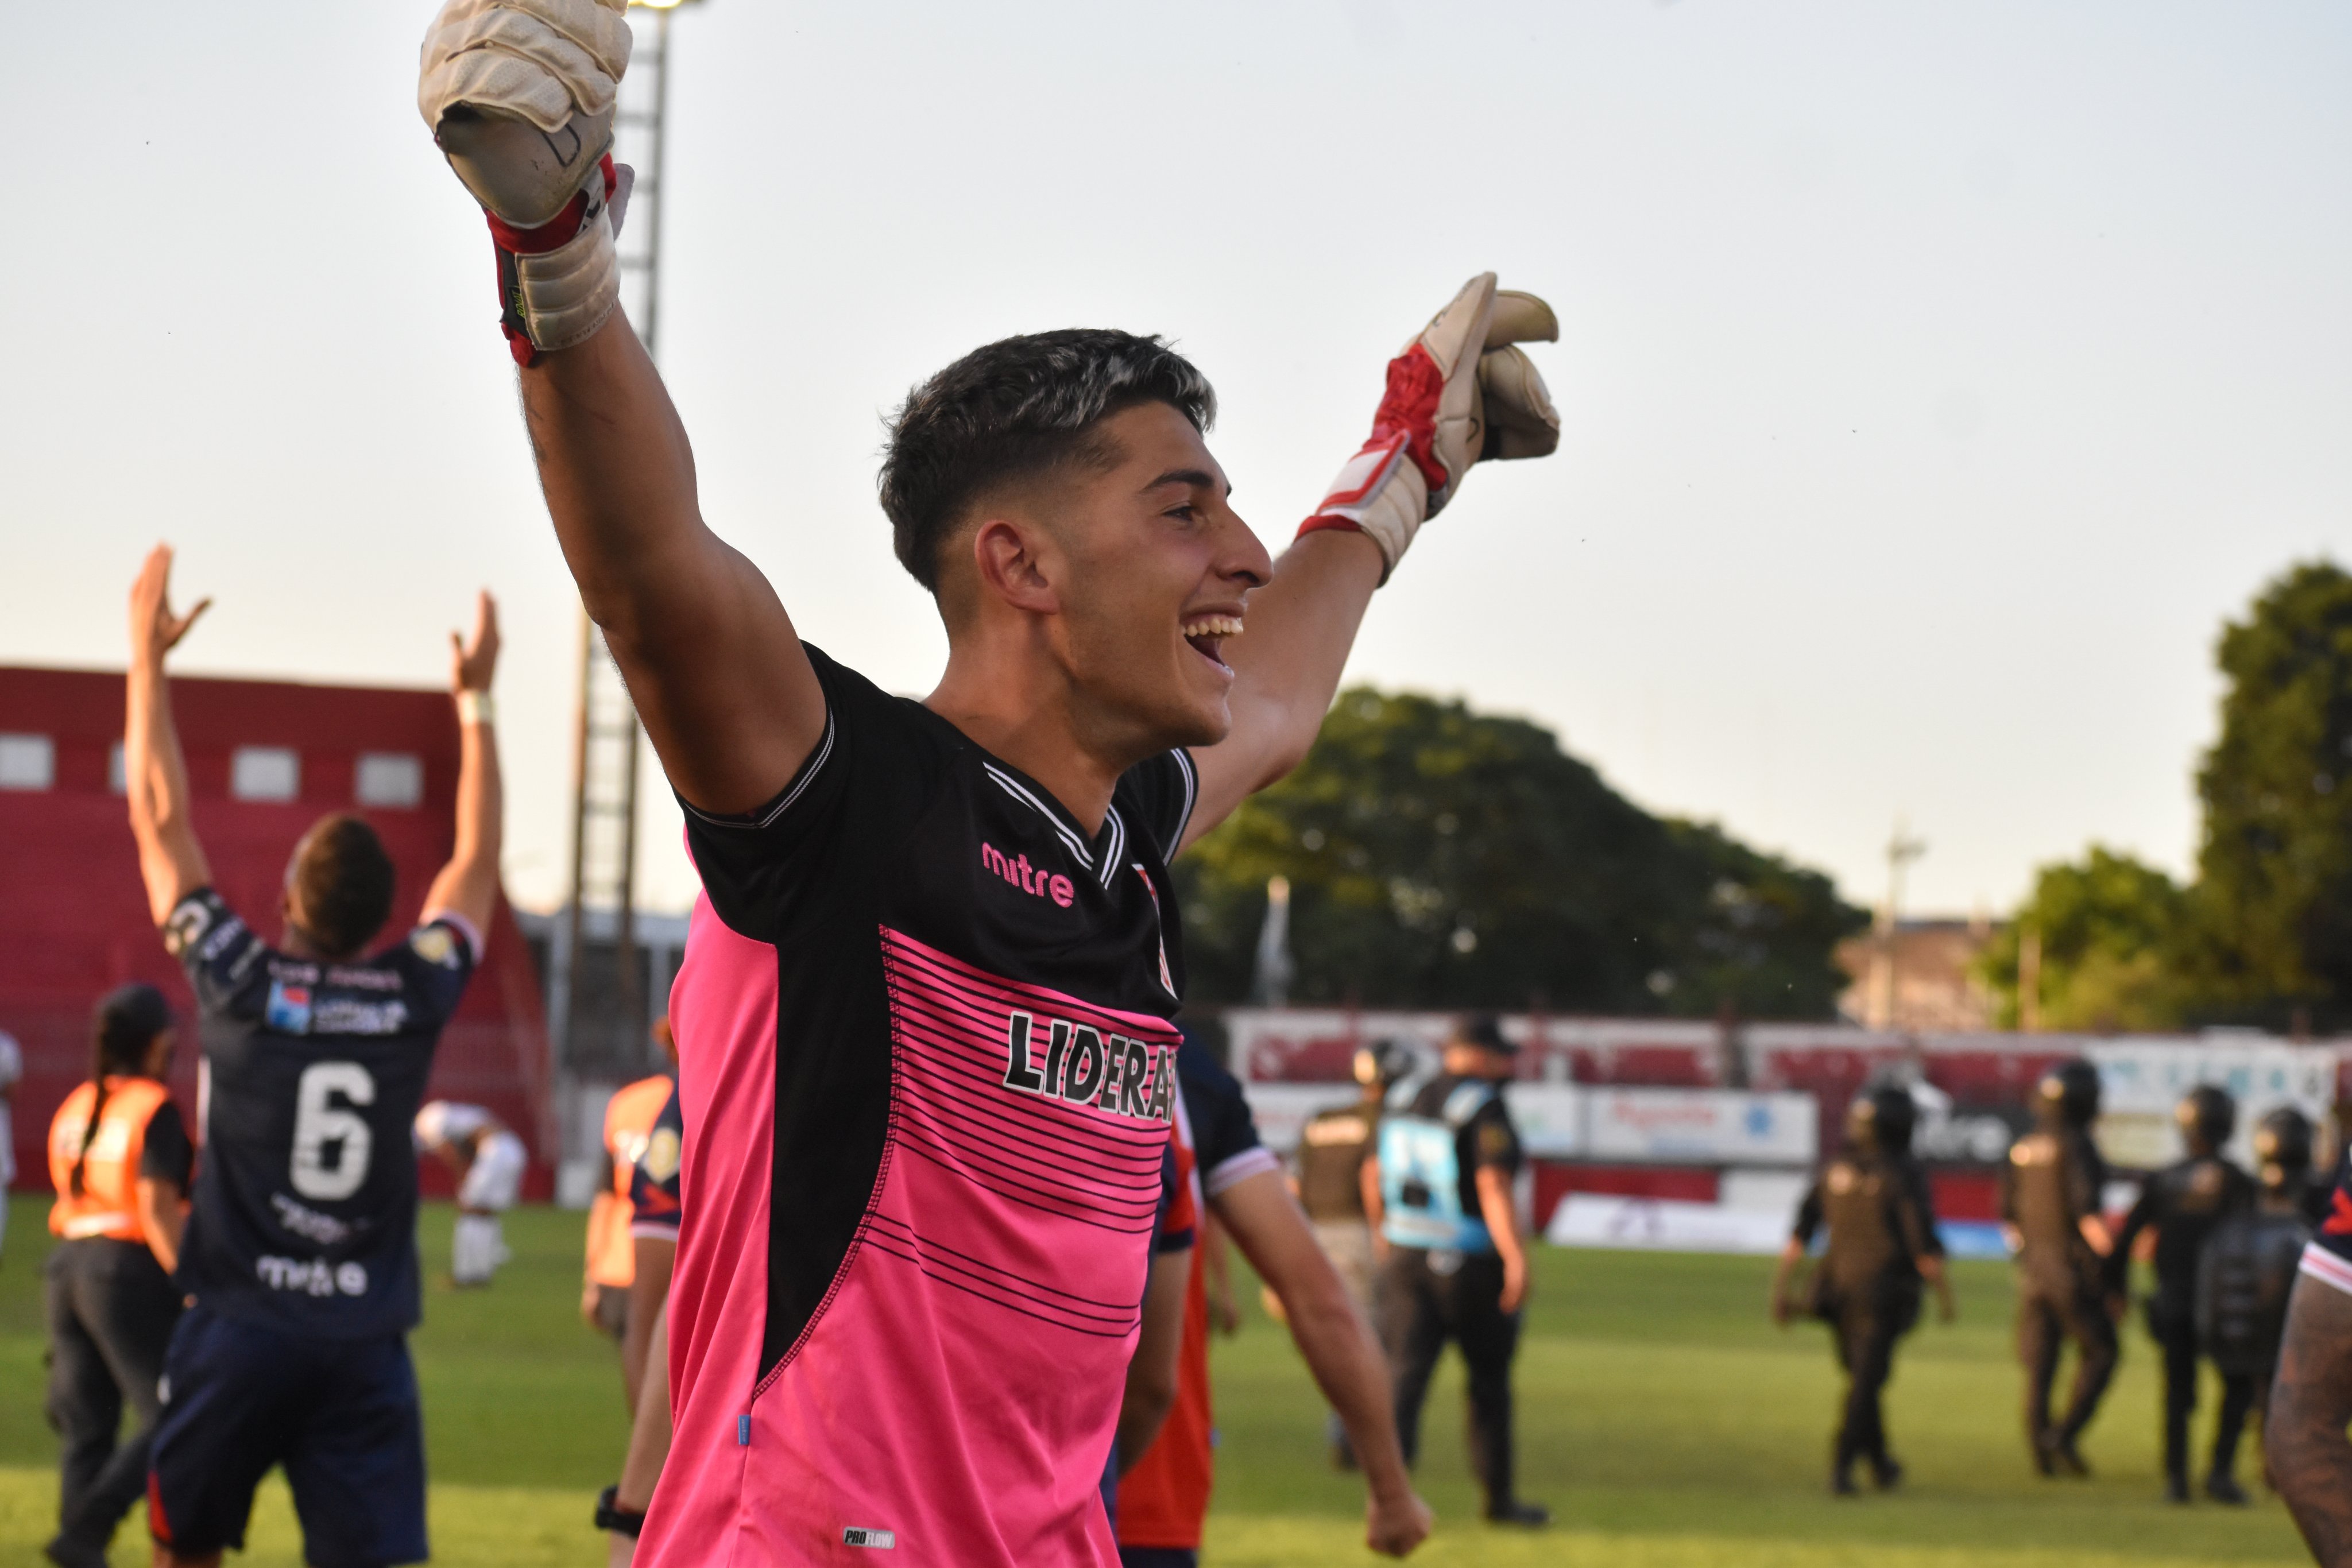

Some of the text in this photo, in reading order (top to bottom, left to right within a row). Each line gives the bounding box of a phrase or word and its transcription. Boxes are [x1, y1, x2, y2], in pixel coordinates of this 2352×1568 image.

[982, 842, 1074, 908] mitre
[289, 1060, 374, 1201] 6
[845, 1530, 892, 1547] PROFLOW
